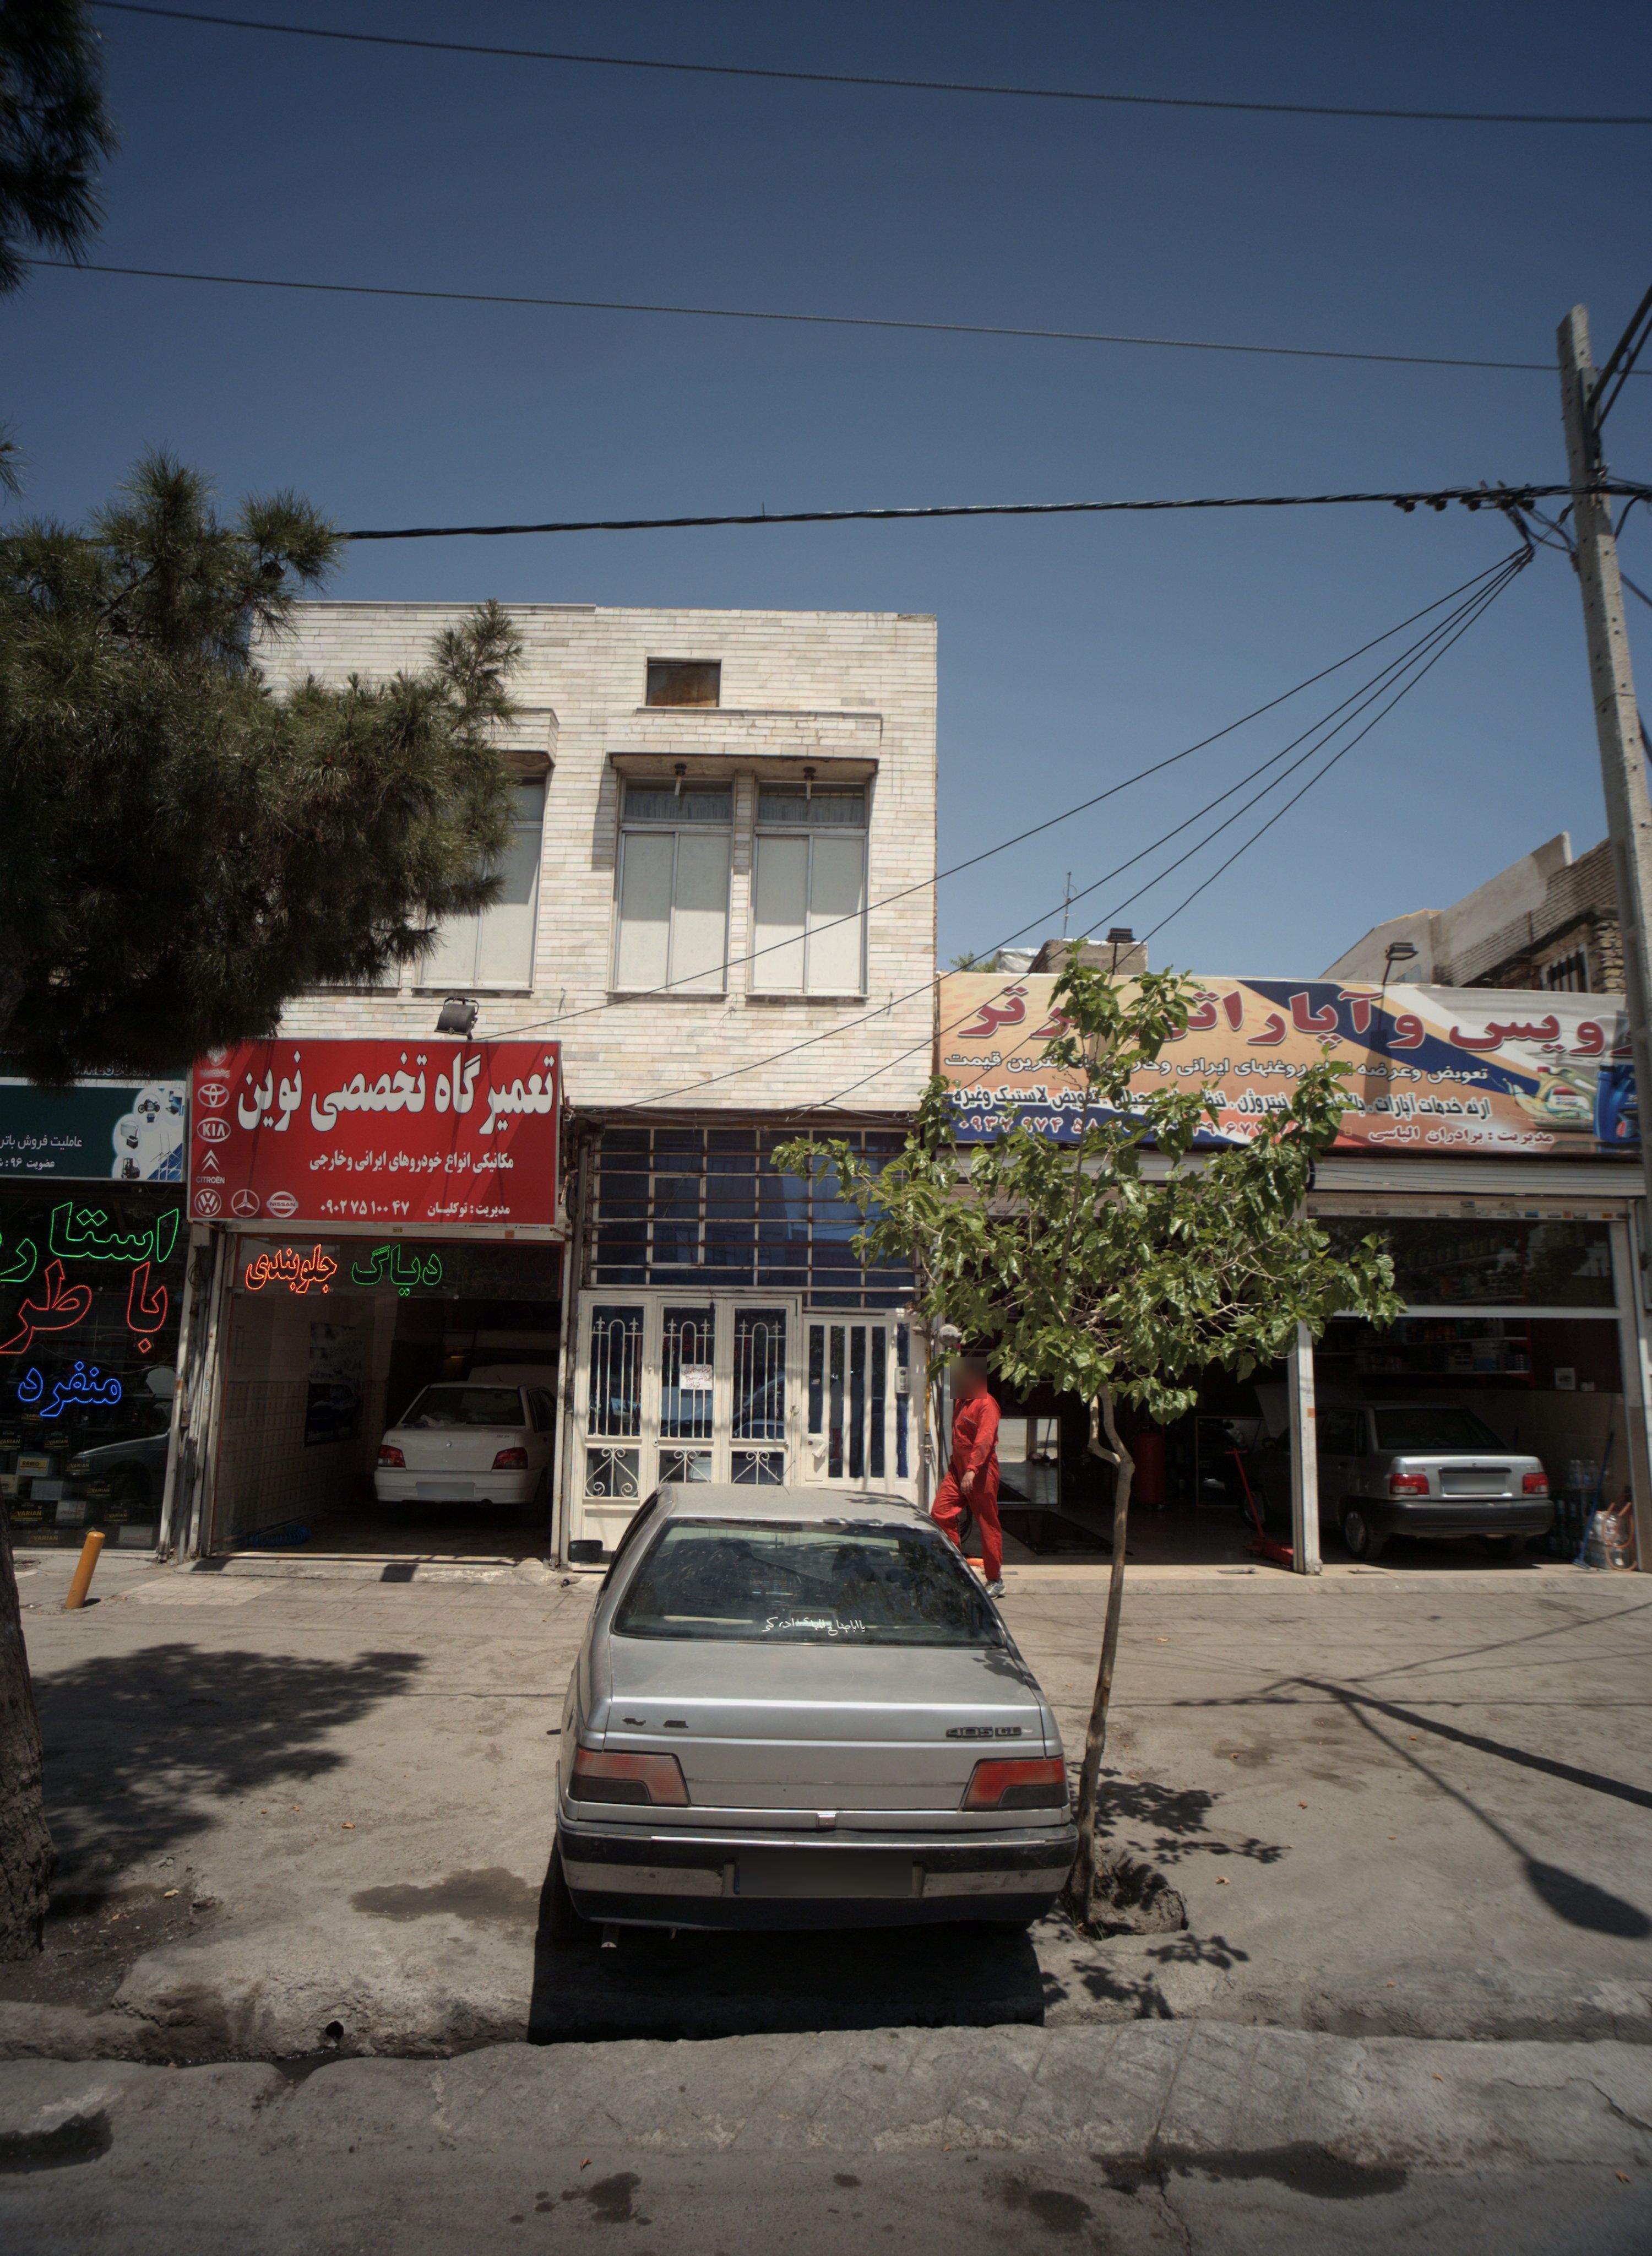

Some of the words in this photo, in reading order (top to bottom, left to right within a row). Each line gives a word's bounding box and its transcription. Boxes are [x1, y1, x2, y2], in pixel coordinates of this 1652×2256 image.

[1387, 1013, 1425, 1049] و
[944, 1051, 1001, 1067] قیمت
[1177, 1058, 1229, 1077] ایرانی
[1234, 1058, 1307, 1079] روغنهای
[434, 1051, 481, 1113] گاه
[1357, 1063, 1422, 1082] وعرضه
[1427, 1067, 1488, 1086] تعویض
[237, 1050, 303, 1132] نوین
[310, 1051, 428, 1132] تخصصی
[478, 1054, 556, 1135] تعمیر
[995, 1086, 1048, 1108] لاستیک
[1238, 1090, 1288, 1113] نیتروژن
[1419, 1099, 1461, 1115] خدمات
[202, 1122, 226, 1137] KIA
[1370, 1125, 1419, 1142] الیاسی
[1427, 1127, 1483, 1144] برادران
[1498, 1131, 1553, 1145] مدیریت
[18, 1134, 48, 1150] فروش
[50, 1135, 83, 1150] عاملیت
[26, 1158, 56, 1171] عضویت
[355, 1149, 387, 1172] ایرانی
[388, 1150, 443, 1173] خودروهای
[444, 1151, 471, 1174] انواع
[472, 1151, 514, 1174] مکانیکی
[427, 1201, 468, 1218] توکلیان
[476, 1202, 511, 1218] مدیریت
[244, 1244, 339, 1294] جلوبندی
[352, 1244, 443, 1296] دیاگ
[127, 1261, 168, 1353] با
[18, 1360, 122, 1418] منفرد
[946, 1726, 993, 1738] 405
